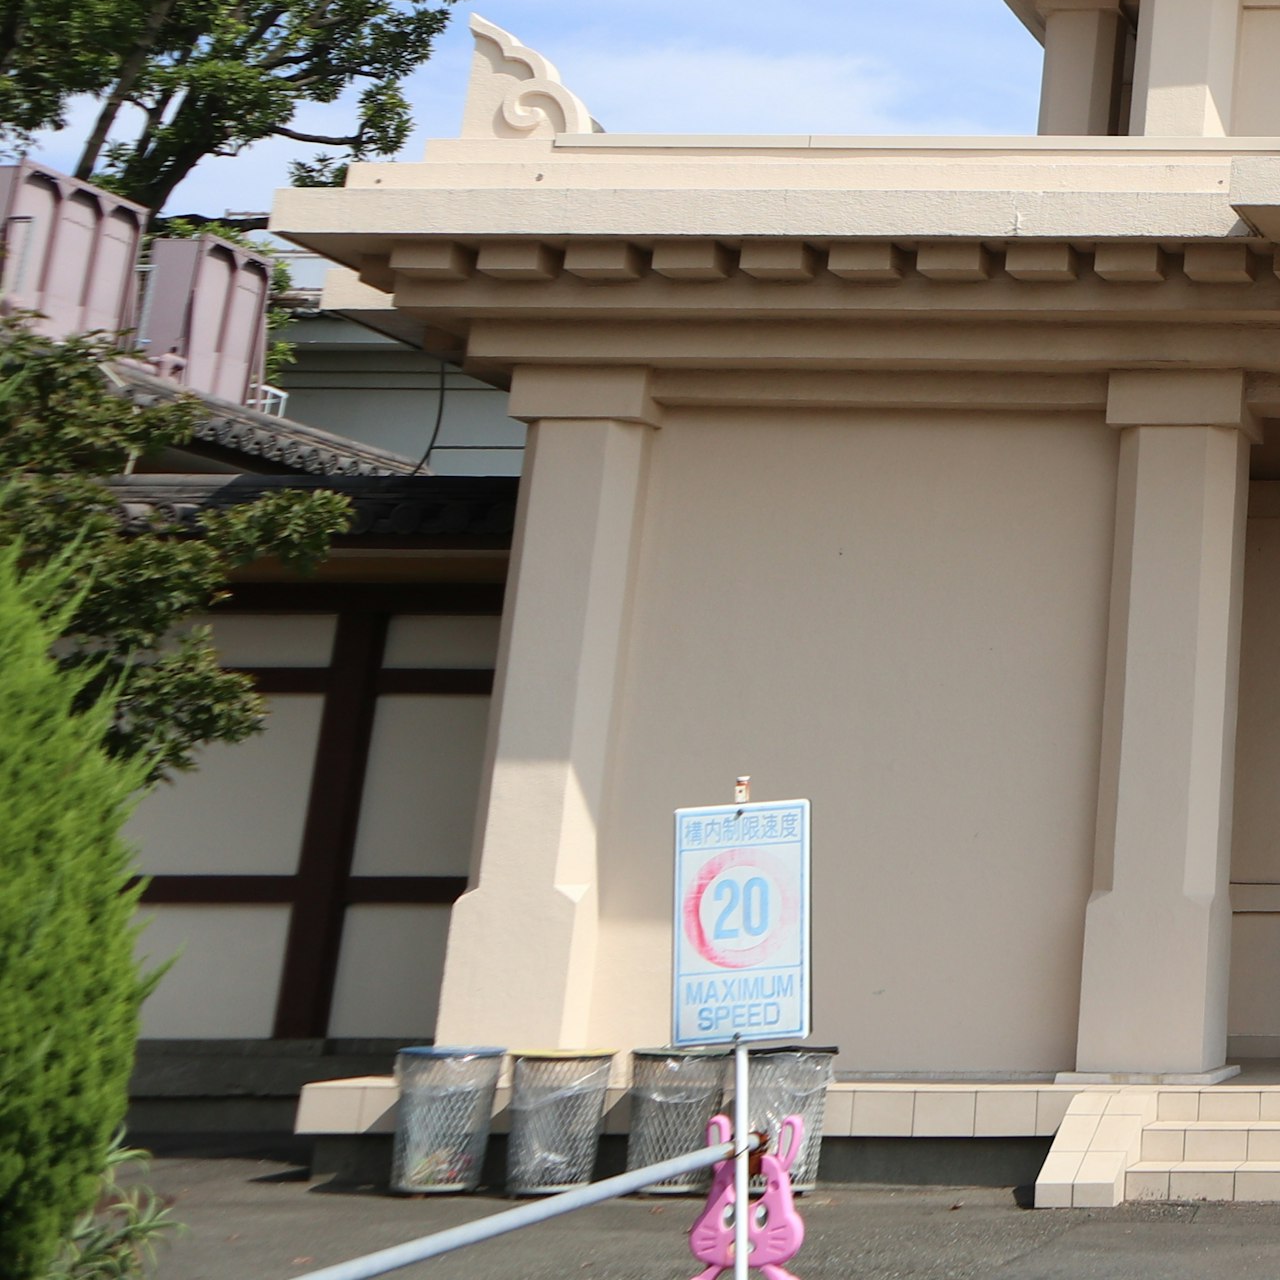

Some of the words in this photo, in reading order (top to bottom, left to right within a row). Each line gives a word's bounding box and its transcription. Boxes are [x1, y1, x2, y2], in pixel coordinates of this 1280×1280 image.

[684, 812, 799, 847] 構内制限速度
[712, 876, 770, 941] 20
[685, 974, 794, 1006] MAXIMUM
[697, 1002, 781, 1032] SPEED
